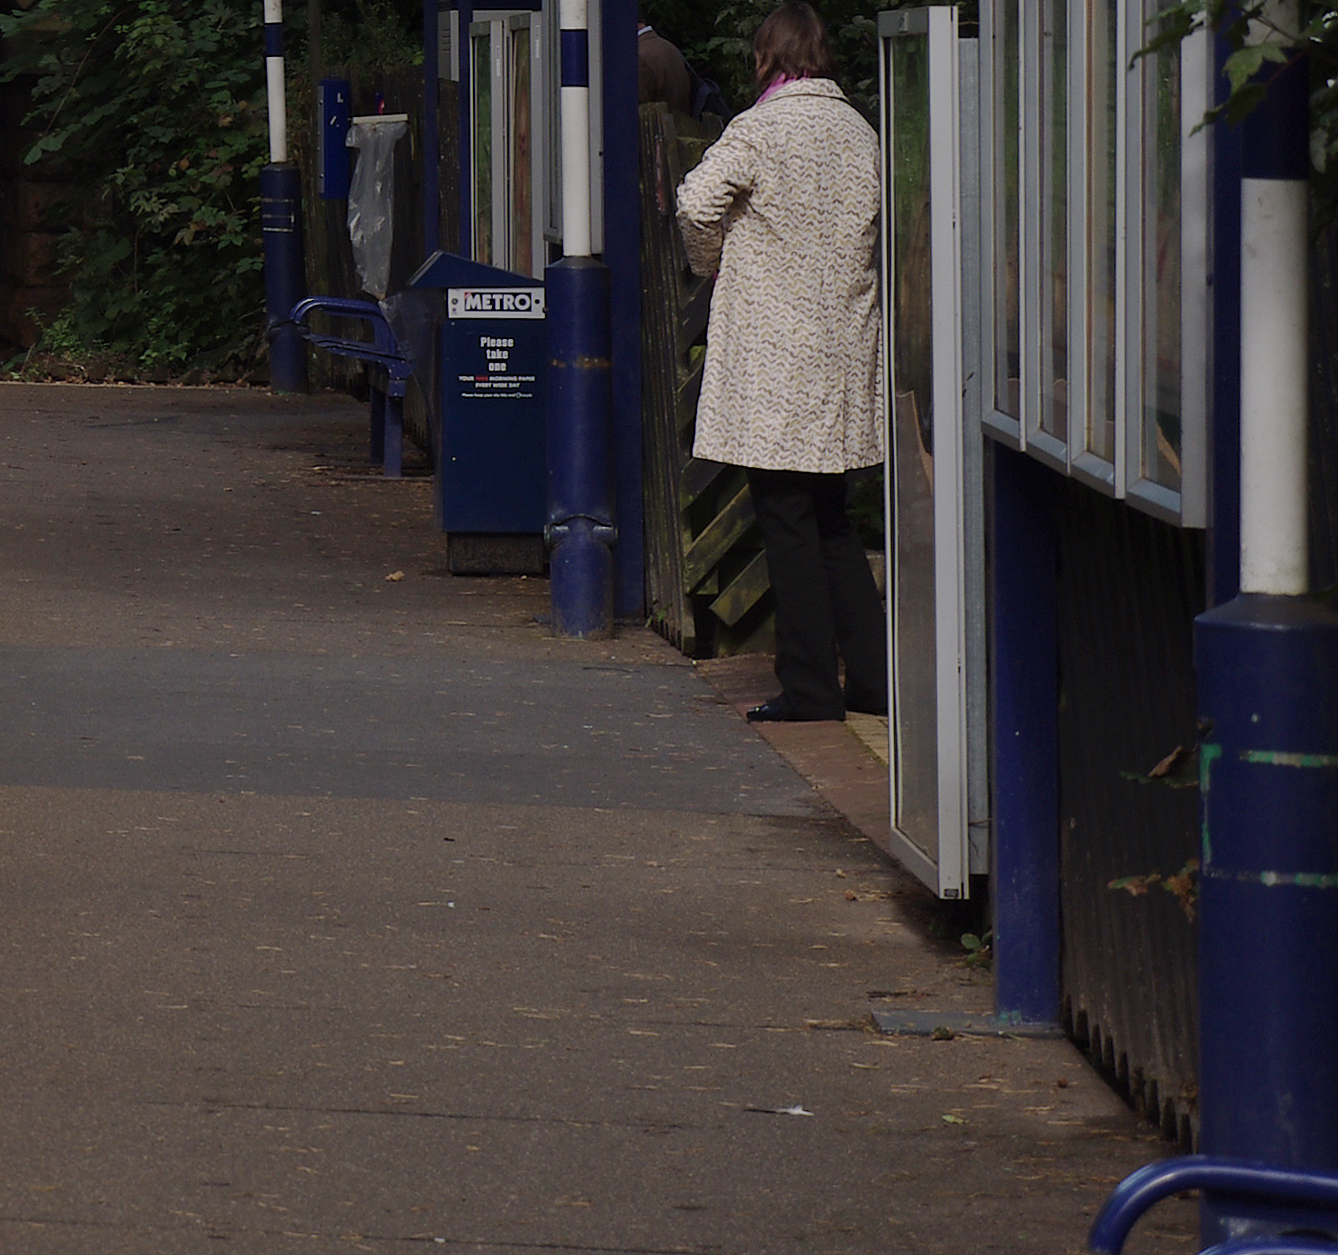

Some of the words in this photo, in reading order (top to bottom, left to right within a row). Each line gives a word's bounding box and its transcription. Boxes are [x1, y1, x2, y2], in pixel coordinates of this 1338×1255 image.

[465, 293, 531, 311] METRO
[480, 336, 514, 348] Please
[486, 349, 509, 360] take
[488, 362, 507, 371] one
